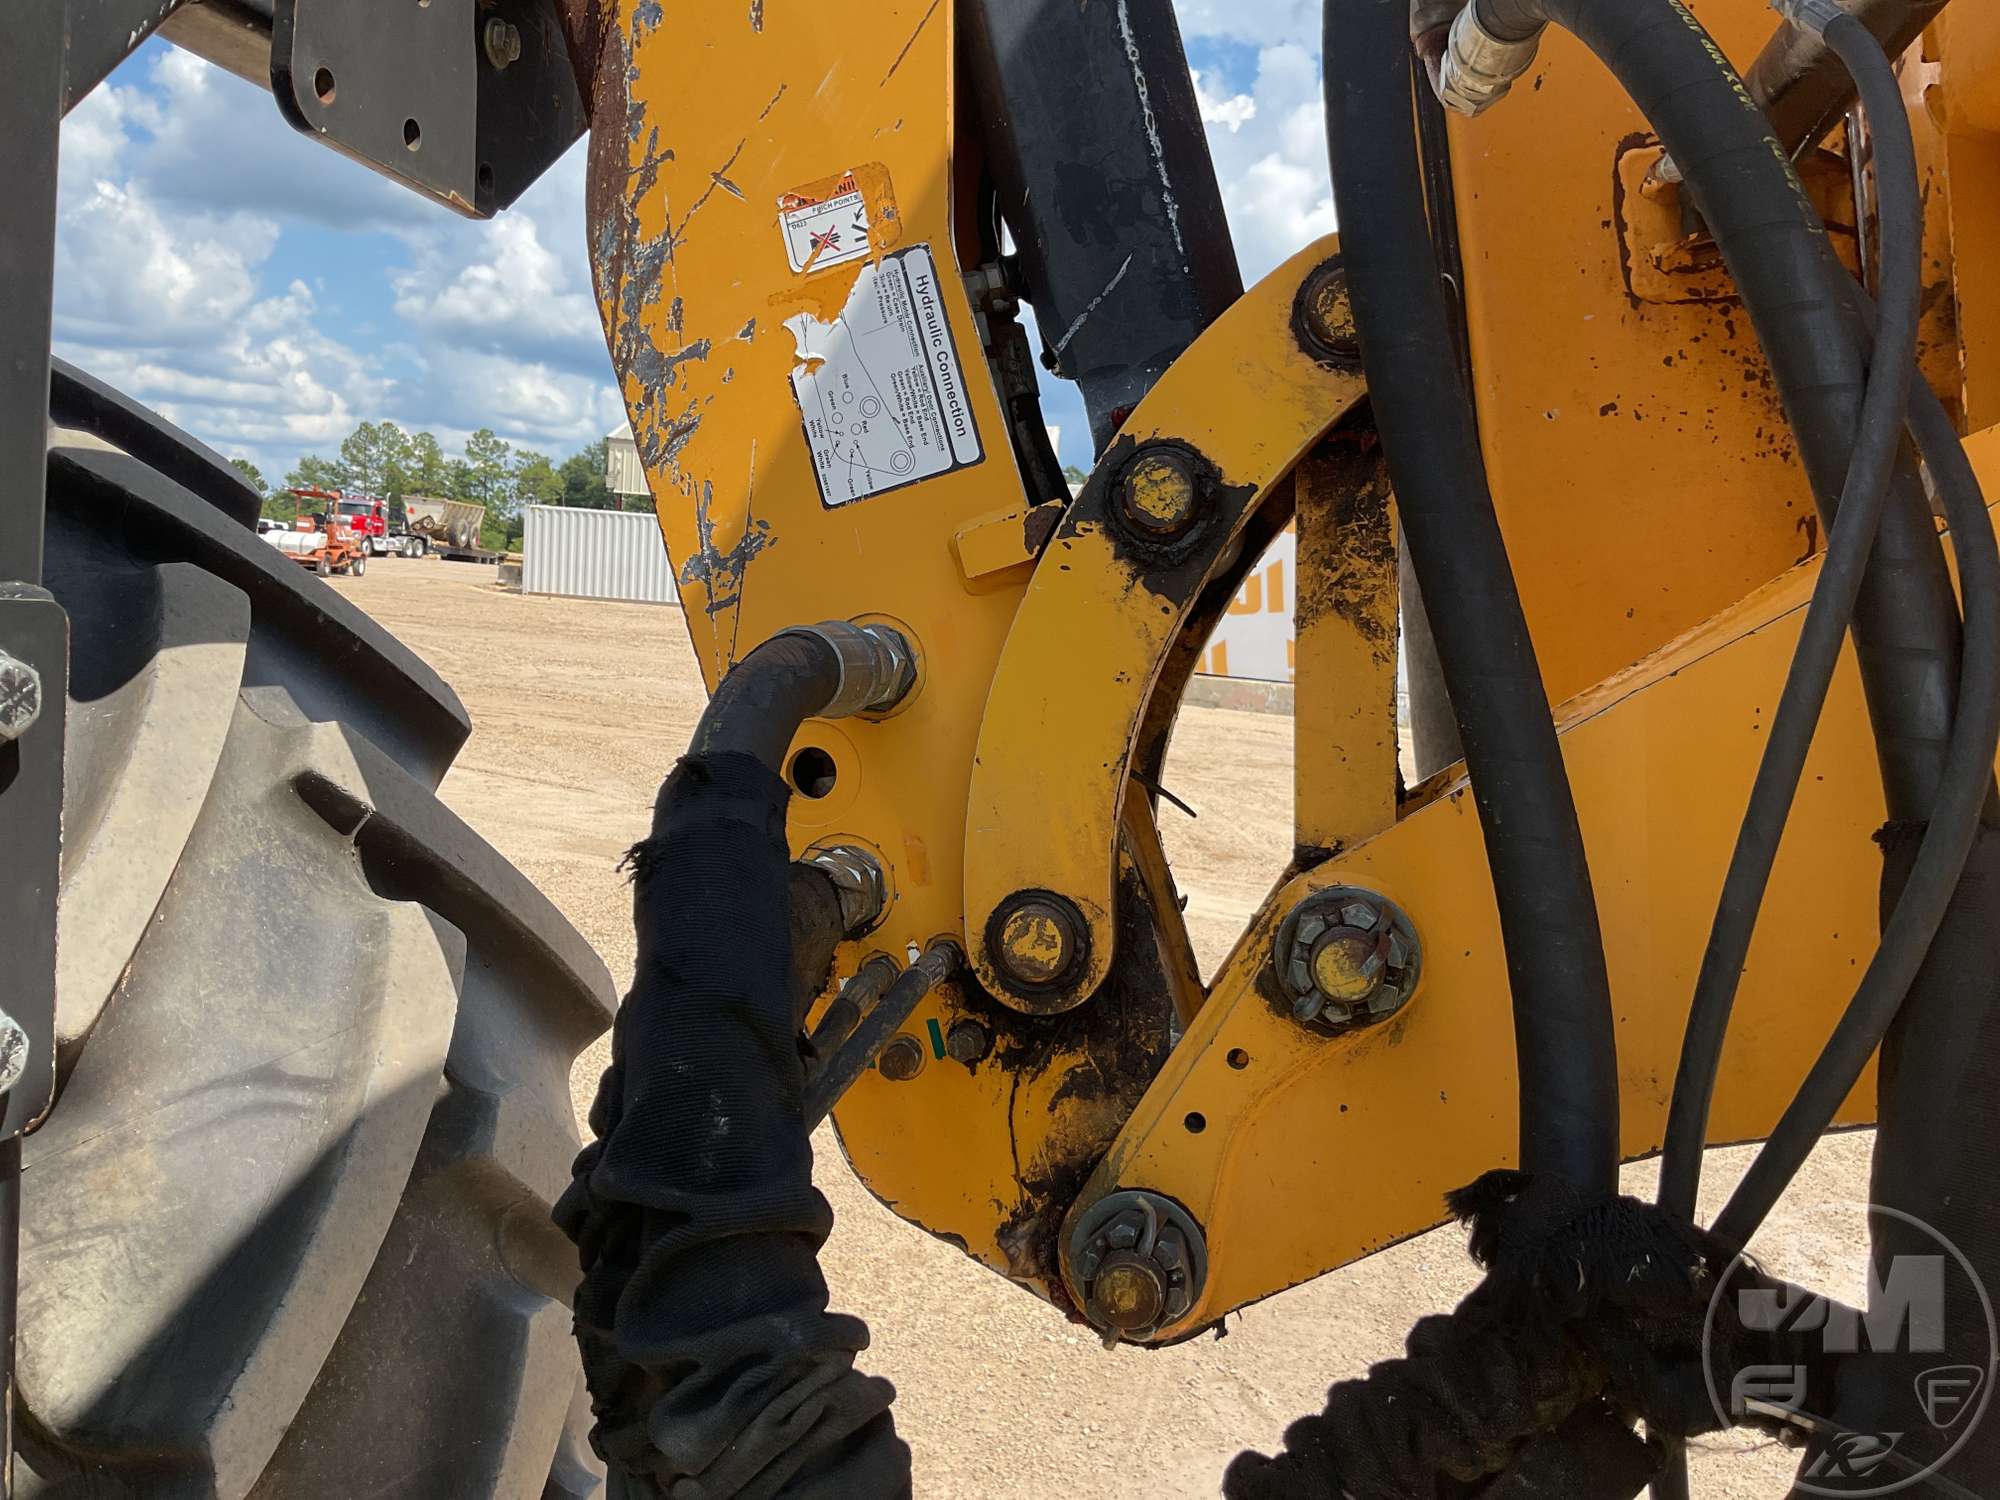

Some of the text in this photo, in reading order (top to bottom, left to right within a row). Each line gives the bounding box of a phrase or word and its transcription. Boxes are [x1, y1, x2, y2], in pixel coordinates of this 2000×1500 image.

[833, 194, 858, 206] POINTS
[906, 320, 919, 356] Connection
[916, 274, 967, 438] Hydraulic Connection
[841, 373, 849, 388] Blue
[897, 370, 905, 390] Green
[827, 390, 836, 410] Green
[903, 396, 912, 410] Rod
[911, 366, 919, 387] Yellow
[921, 408, 929, 421] End
[861, 420, 869, 433] Red
[907, 410, 915, 424] End
[926, 394, 934, 410] Door
[930, 411, 944, 451] Connections
[809, 419, 817, 438] White
[815, 417, 824, 438] Yellow
[902, 418, 910, 434] Base
[906, 435, 914, 449] End
[916, 415, 924, 431] Base
[920, 432, 928, 445] End
[816, 450, 824, 469] White
[823, 449, 831, 468] Green
[847, 478, 855, 497] Green
[865, 469, 873, 489] Yellow
